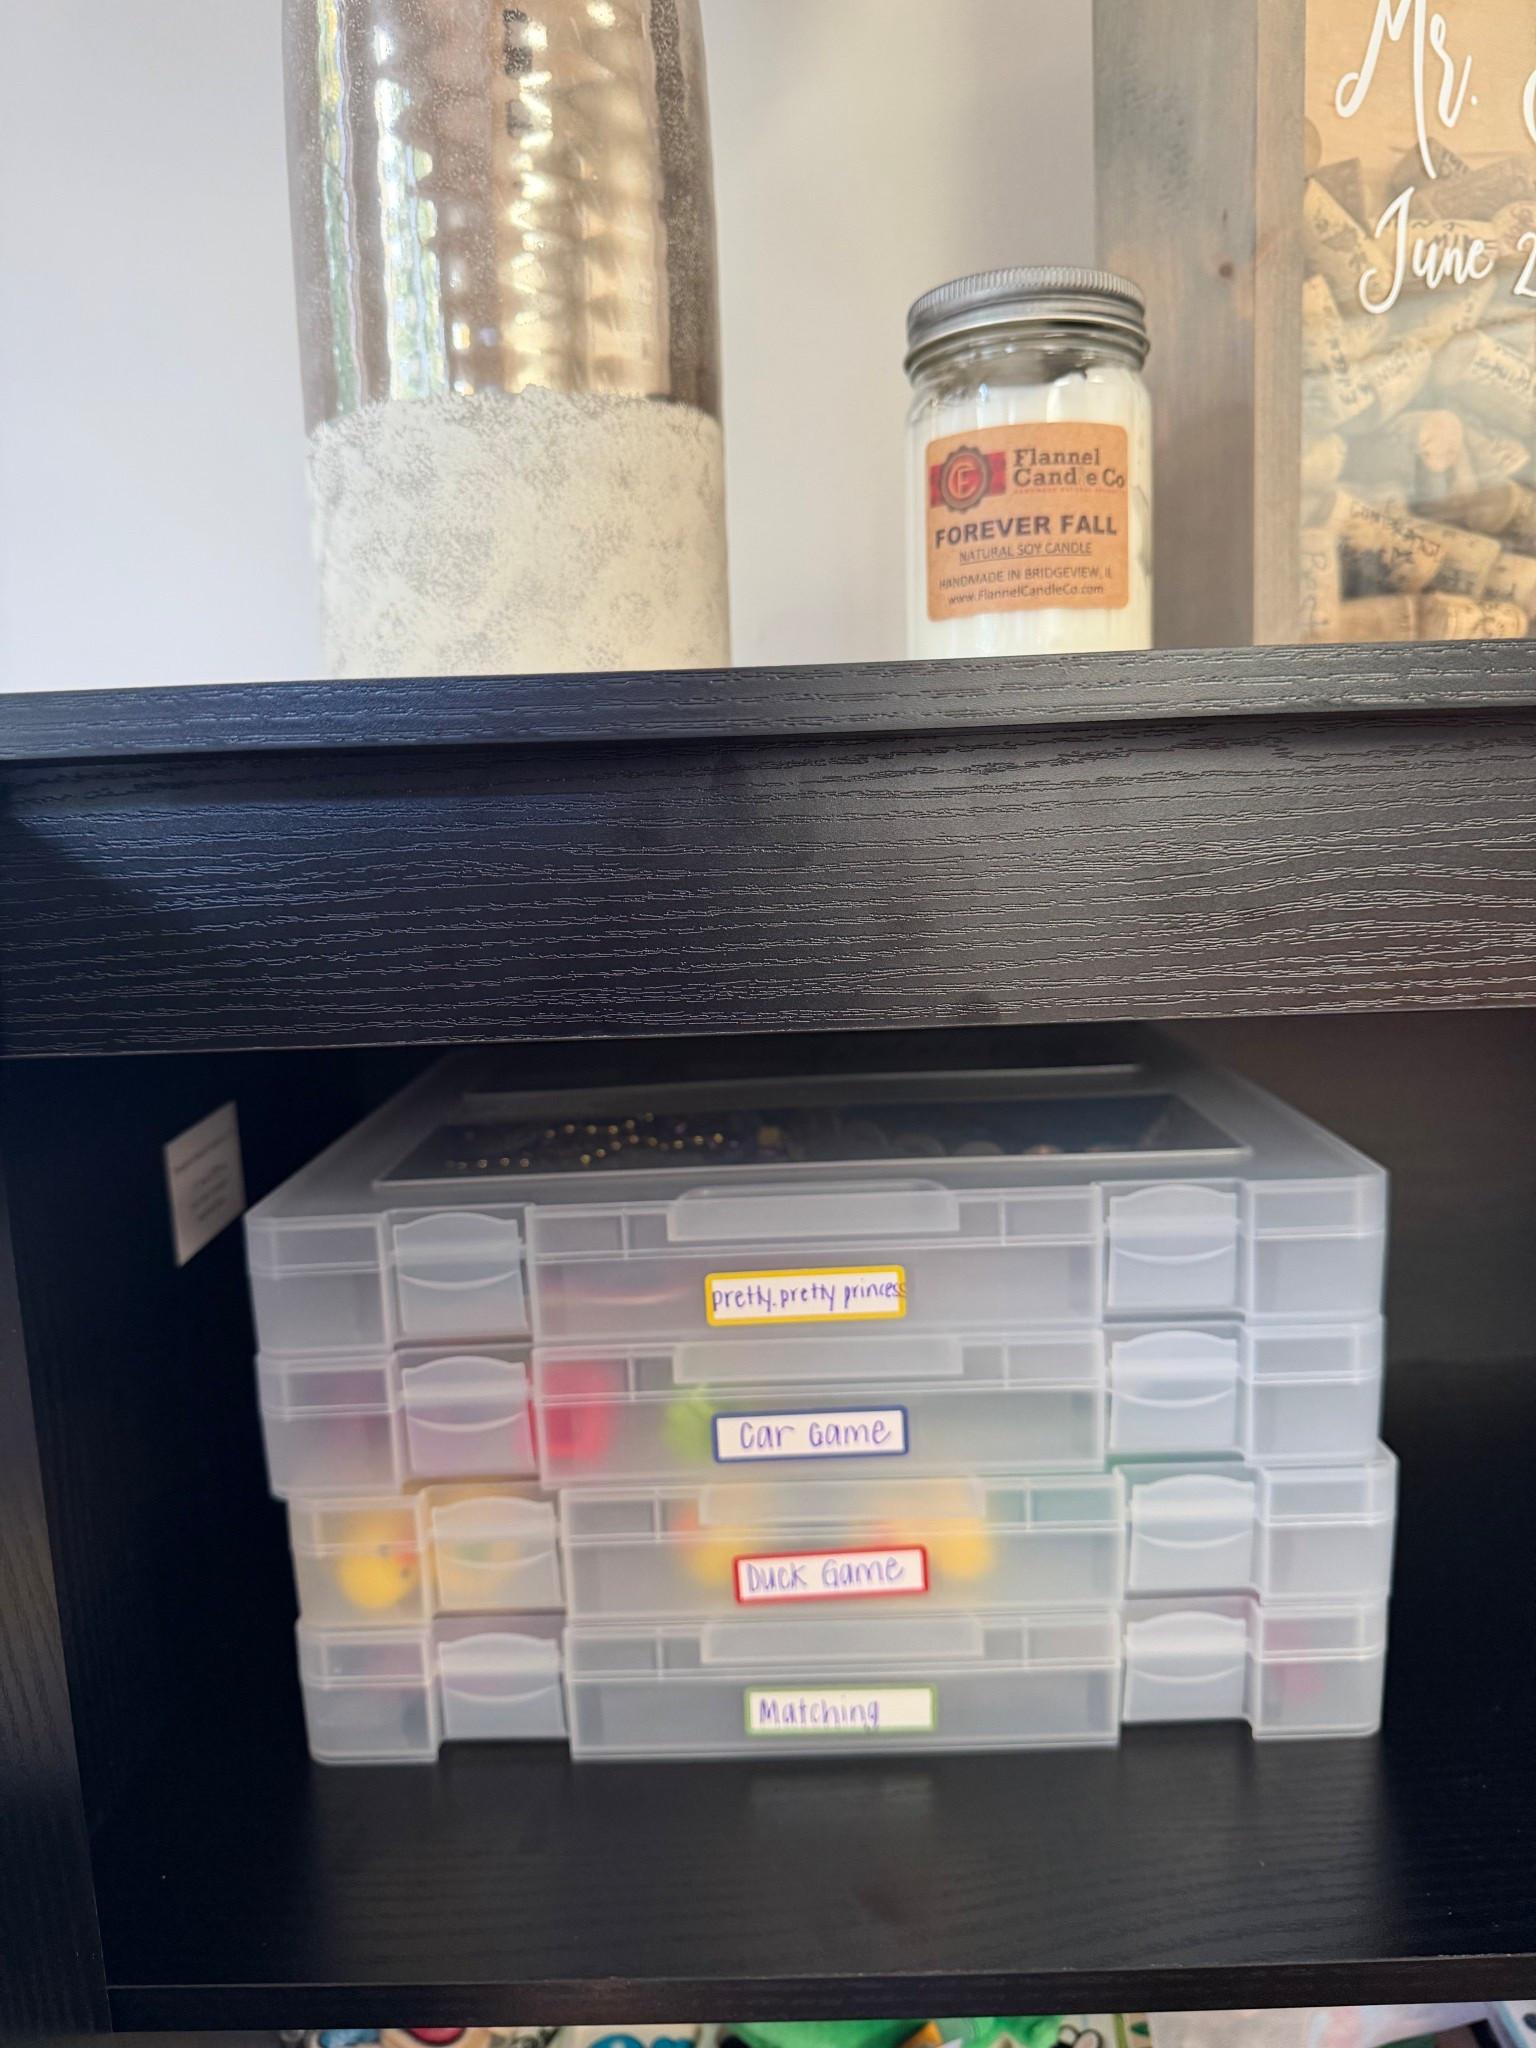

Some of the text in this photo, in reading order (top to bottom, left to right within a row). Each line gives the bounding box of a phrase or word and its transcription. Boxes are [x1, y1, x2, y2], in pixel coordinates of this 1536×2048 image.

[1335, 0, 1478, 179] Mr.
[1359, 186, 1494, 315] June
[1013, 448, 1100, 467] Flannel
[1012, 467, 1125, 488] Cande Co
[935, 514, 1117, 549] FOREVER FALL
[959, 541, 1093, 564] NATURAL SOY CANDLE
[939, 570, 1003, 590] HANDMADE
[1007, 568, 1020, 580] IN
[1104, 566, 1113, 580] IL
[947, 584, 1104, 606] www.FlannelCandleCo.com
[780, 1281, 836, 1312] pretty
[843, 1281, 907, 1310] princess
[739, 1418, 892, 1450] Car Game
[746, 1556, 905, 1593] Duck Game
[758, 1697, 880, 1733] Matching
